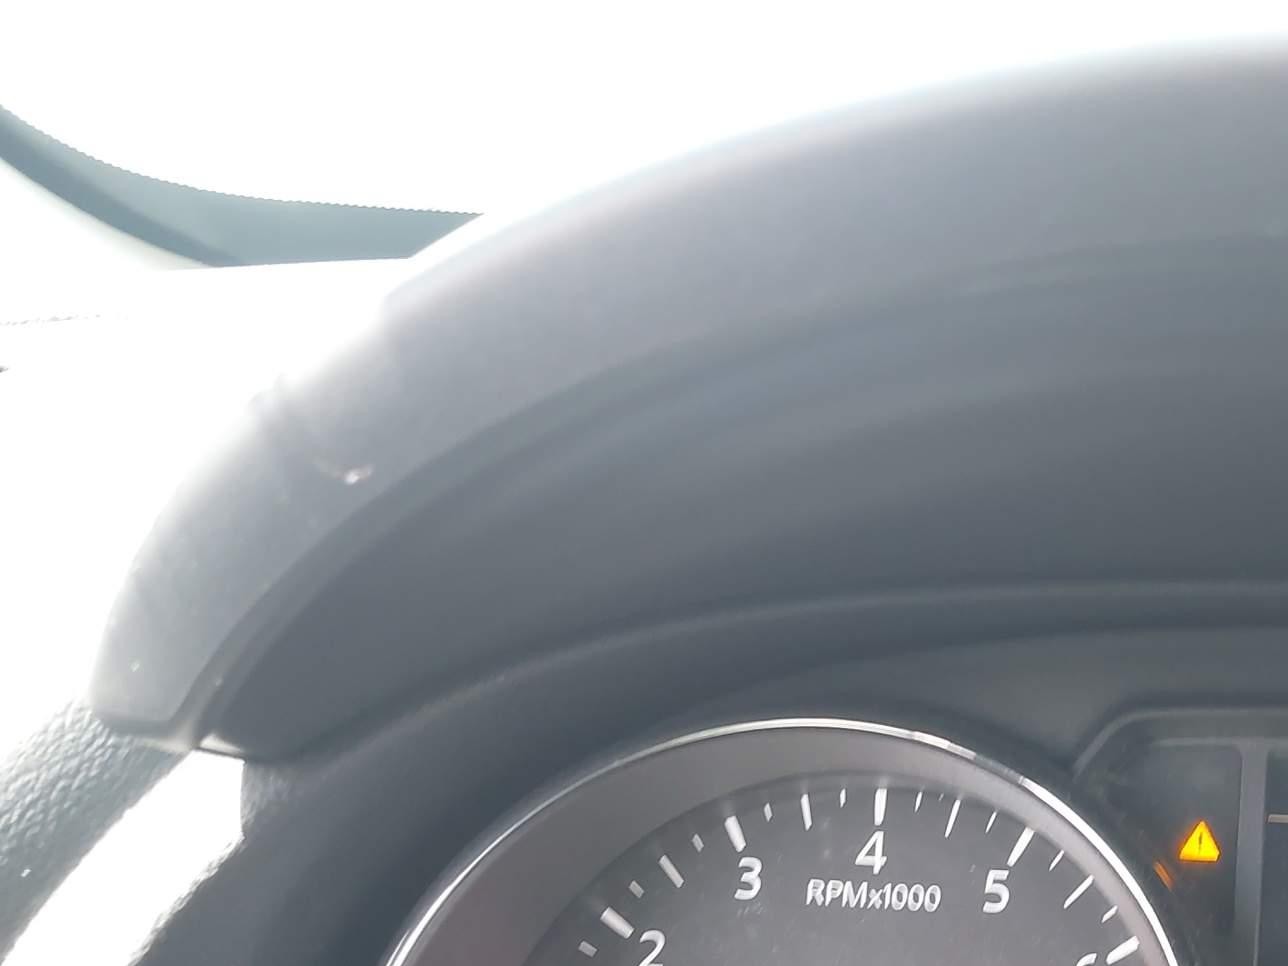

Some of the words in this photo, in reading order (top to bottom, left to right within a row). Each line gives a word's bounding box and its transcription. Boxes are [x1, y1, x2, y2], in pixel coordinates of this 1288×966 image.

[855, 831, 887, 875] 4
[734, 857, 763, 900] 3
[806, 878, 942, 913] RPMx1000
[982, 869, 1010, 914] 5
